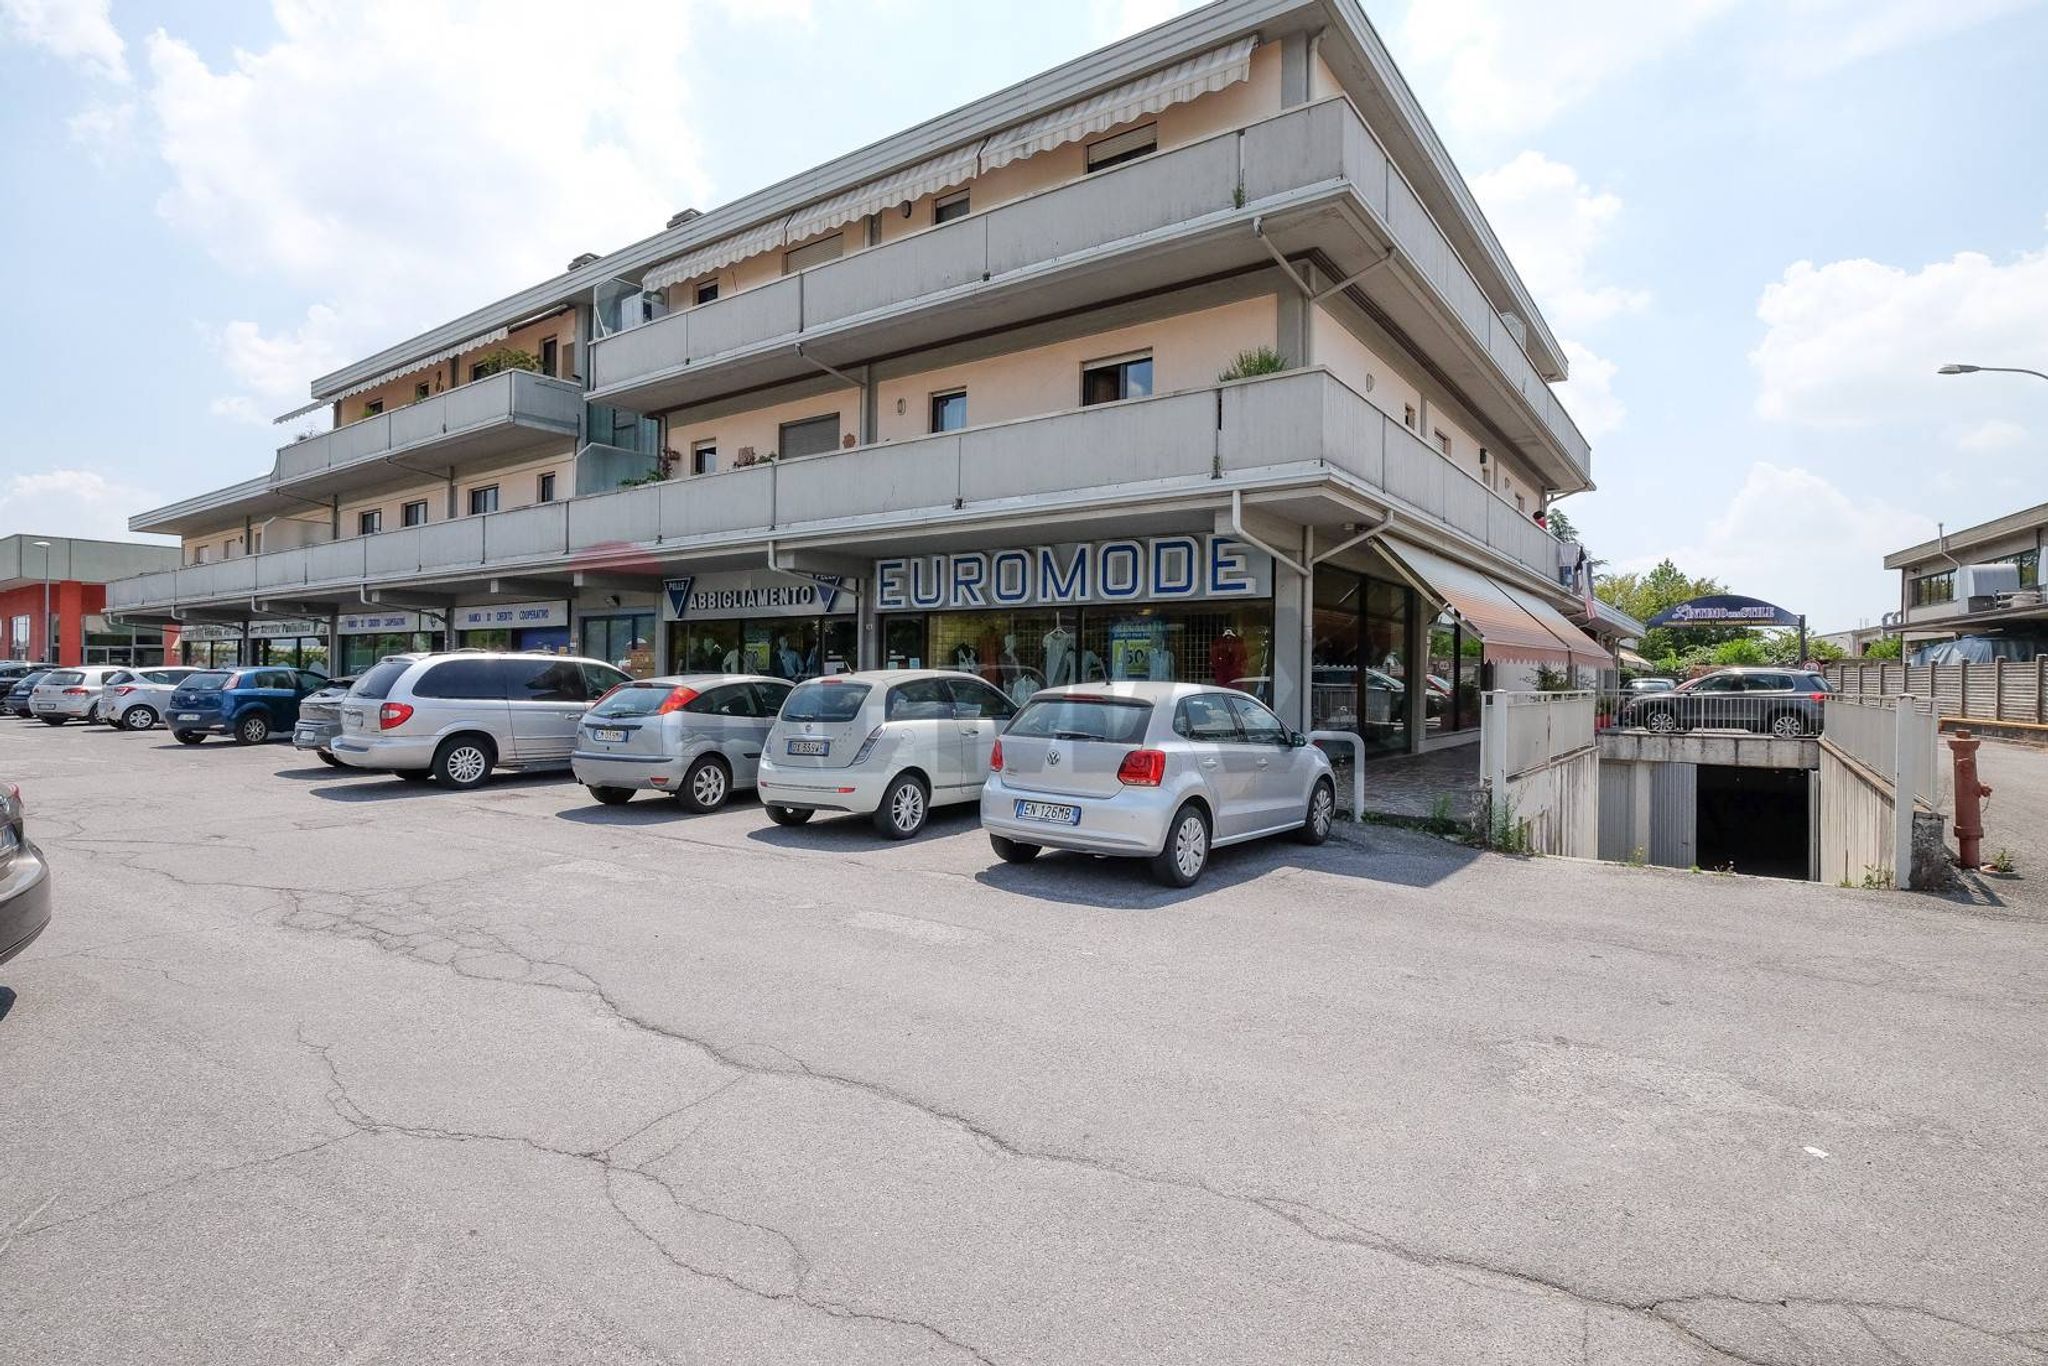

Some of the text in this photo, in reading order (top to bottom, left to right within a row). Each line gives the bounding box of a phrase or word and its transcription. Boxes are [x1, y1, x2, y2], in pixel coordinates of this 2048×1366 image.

[876, 534, 1257, 609] EUROMODE
[668, 581, 685, 591] PELLE
[688, 586, 812, 610] ABBIGLIAMENTO
[1023, 803, 1072, 820] EN 126MB
